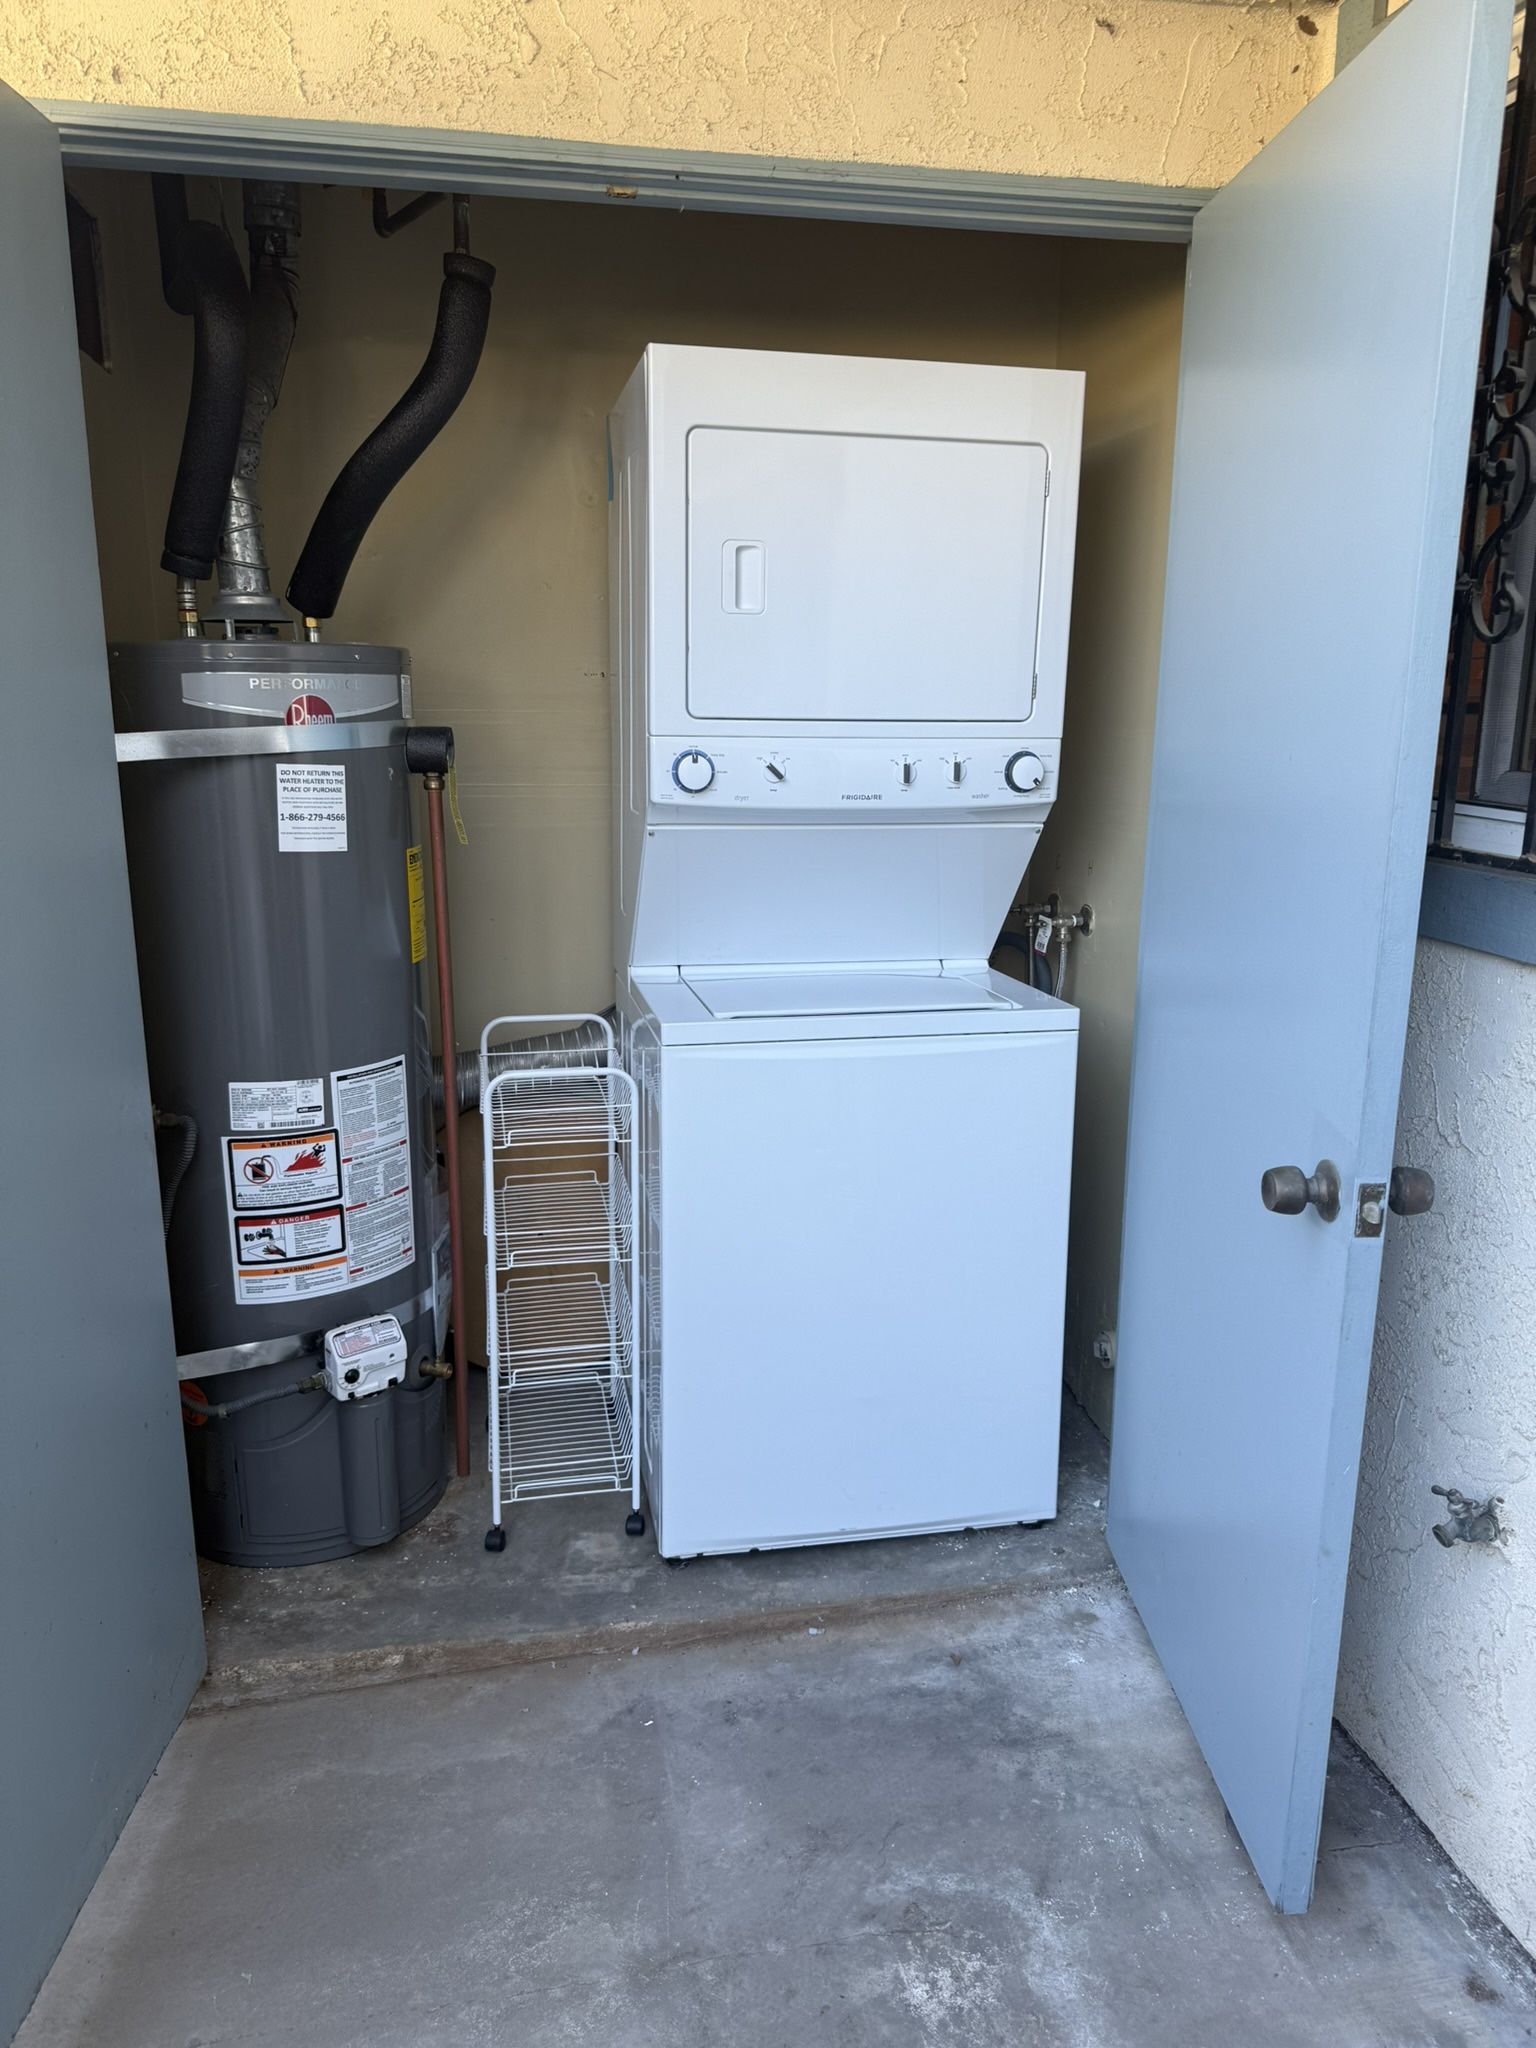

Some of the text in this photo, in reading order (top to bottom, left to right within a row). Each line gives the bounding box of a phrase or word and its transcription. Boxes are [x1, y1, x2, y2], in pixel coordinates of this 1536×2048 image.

[734, 794, 750, 802] dryer
[280, 813, 346, 821] 1-866-279-4566
[269, 1139, 307, 1148] WARNING
[278, 1215, 310, 1224] DANGER
[283, 1264, 315, 1273] WARNING
